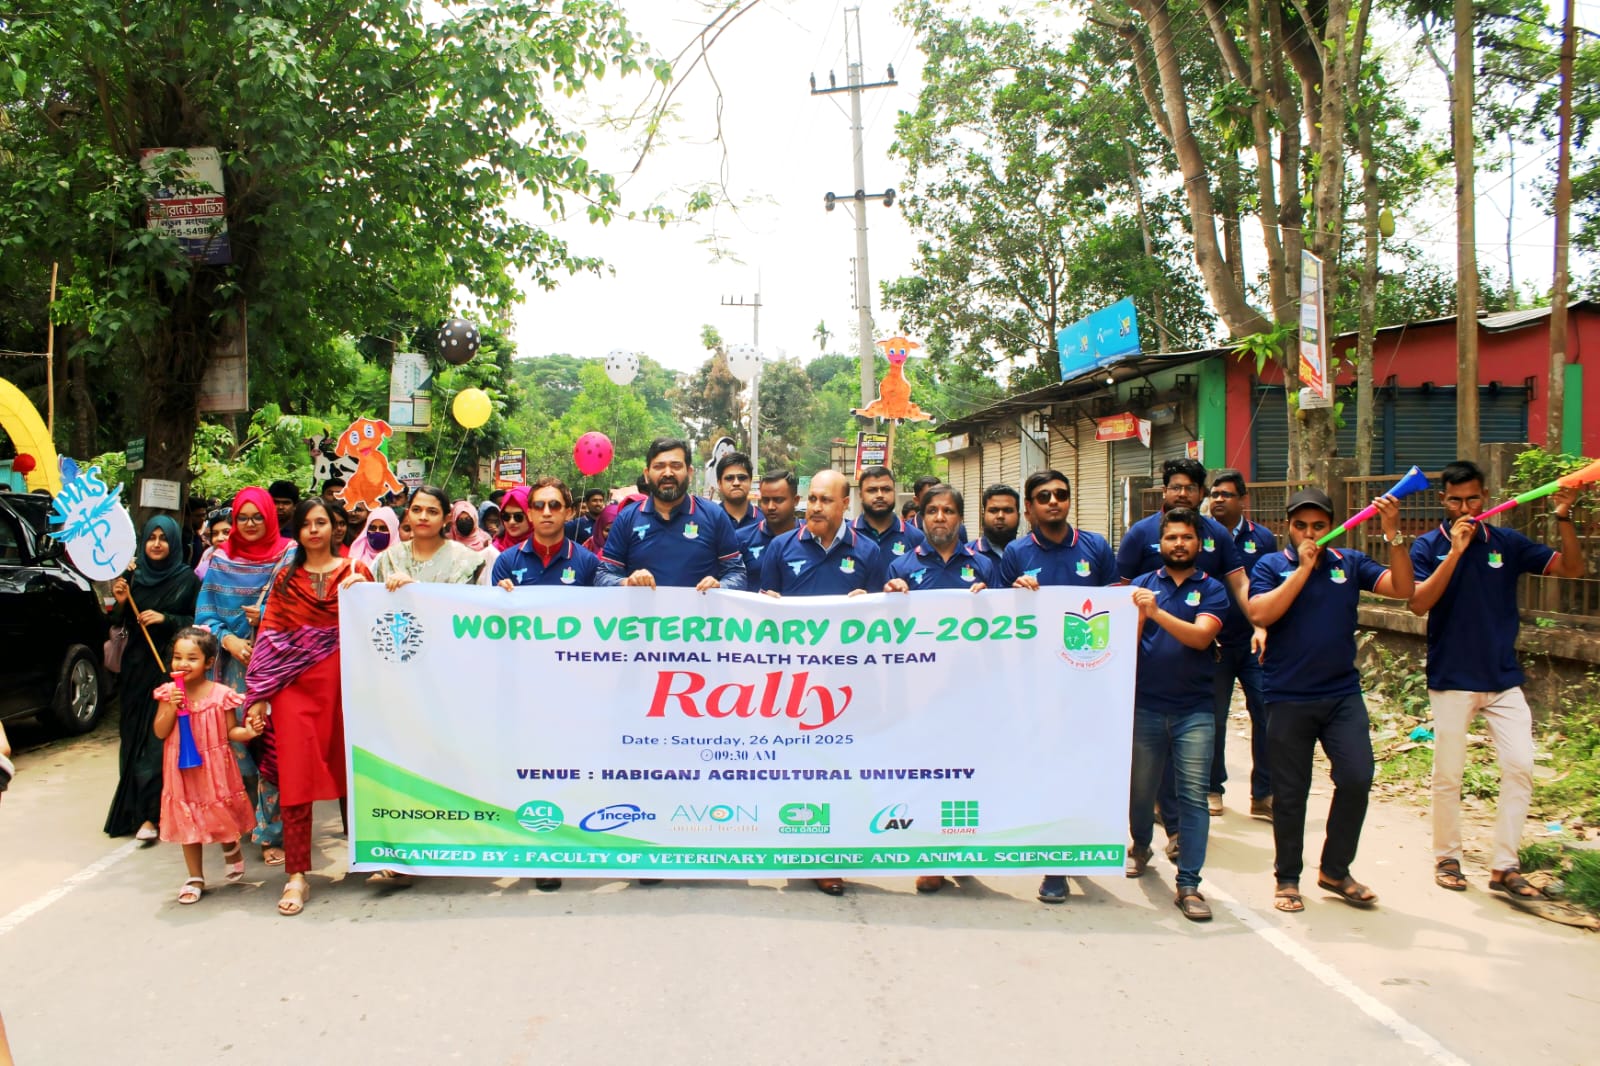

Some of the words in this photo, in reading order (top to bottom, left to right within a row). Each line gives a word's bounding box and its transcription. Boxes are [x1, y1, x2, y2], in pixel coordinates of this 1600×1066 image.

[452, 614, 582, 641] WORLD
[593, 615, 830, 646] VETERINARY
[555, 651, 628, 662] THEME:
[634, 651, 711, 663] ANIMAL
[718, 652, 791, 665] HEALTH
[796, 654, 858, 665] TAKES
[863, 654, 877, 665] A
[881, 652, 936, 664] TEAM
[646, 670, 853, 731] Rally
[622, 735, 659, 745] Date
[671, 735, 745, 747] Saturday,
[749, 735, 769, 745] 26
[773, 734, 810, 747] April
[815, 734, 854, 745] 2025
[714, 750, 749, 761] 09:30
[753, 750, 777, 761] AM
[516, 768, 581, 780] VENUE
[601, 769, 700, 780] HABIGANJ
[708, 769, 852, 781] AGRICULTURAL
[860, 768, 975, 780] UNIVERSITY
[372, 808, 470, 821] SPONSORED
[474, 810, 500, 821] BY:
[522, 805, 553, 818] ACI
[599, 808, 657, 824] incepta
[670, 804, 758, 823] AVON
[370, 846, 476, 862] ORGANIZED
[482, 850, 508, 862] BY
[525, 850, 613, 863] FACULTY
[617, 852, 642, 864] OF
[647, 852, 765, 865] VETERINARY
[773, 853, 868, 865] MEDICINE
[872, 852, 910, 864] AND
[917, 851, 988, 863] ANIMAL
